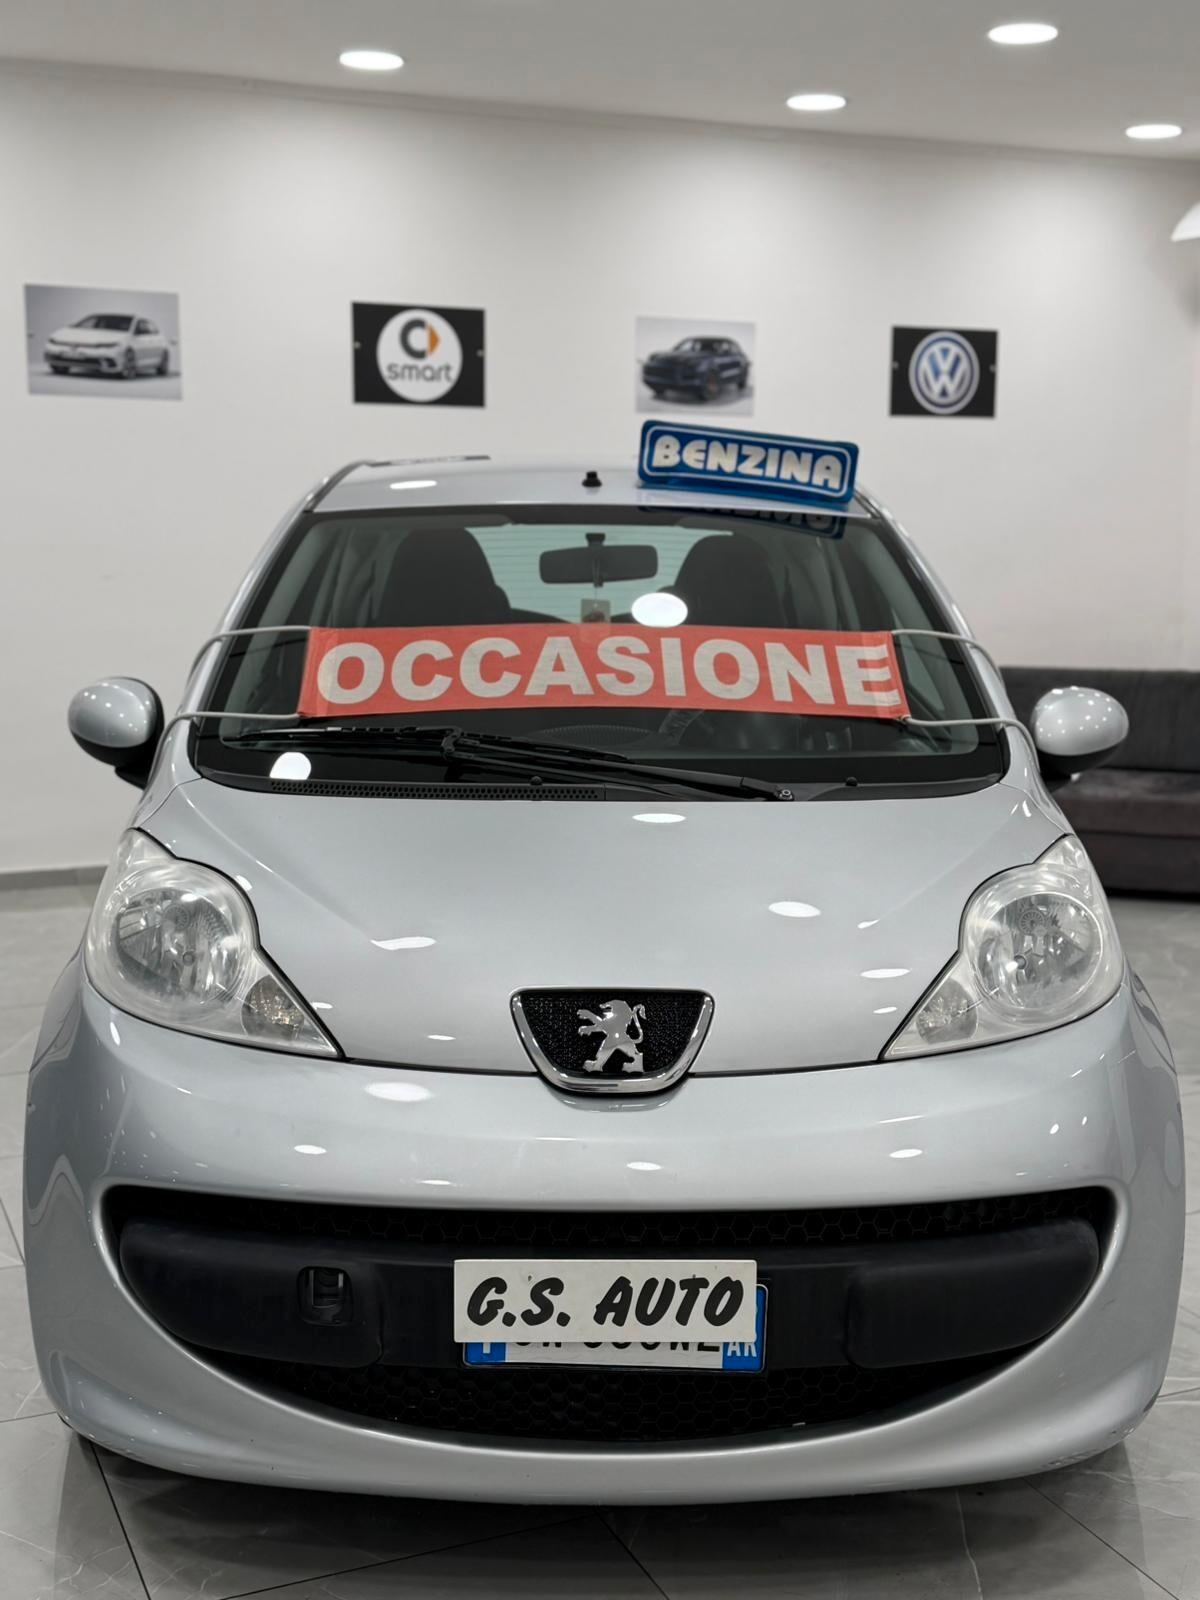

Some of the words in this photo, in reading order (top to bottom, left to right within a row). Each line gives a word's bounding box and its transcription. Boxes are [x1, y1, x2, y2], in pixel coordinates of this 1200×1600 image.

[386, 363, 454, 382] smart
[652, 434, 843, 490] BENZINA
[316, 635, 901, 707] OCCASIONE
[467, 1276, 571, 1327] G.S.
[593, 1275, 744, 1327] AUTO
